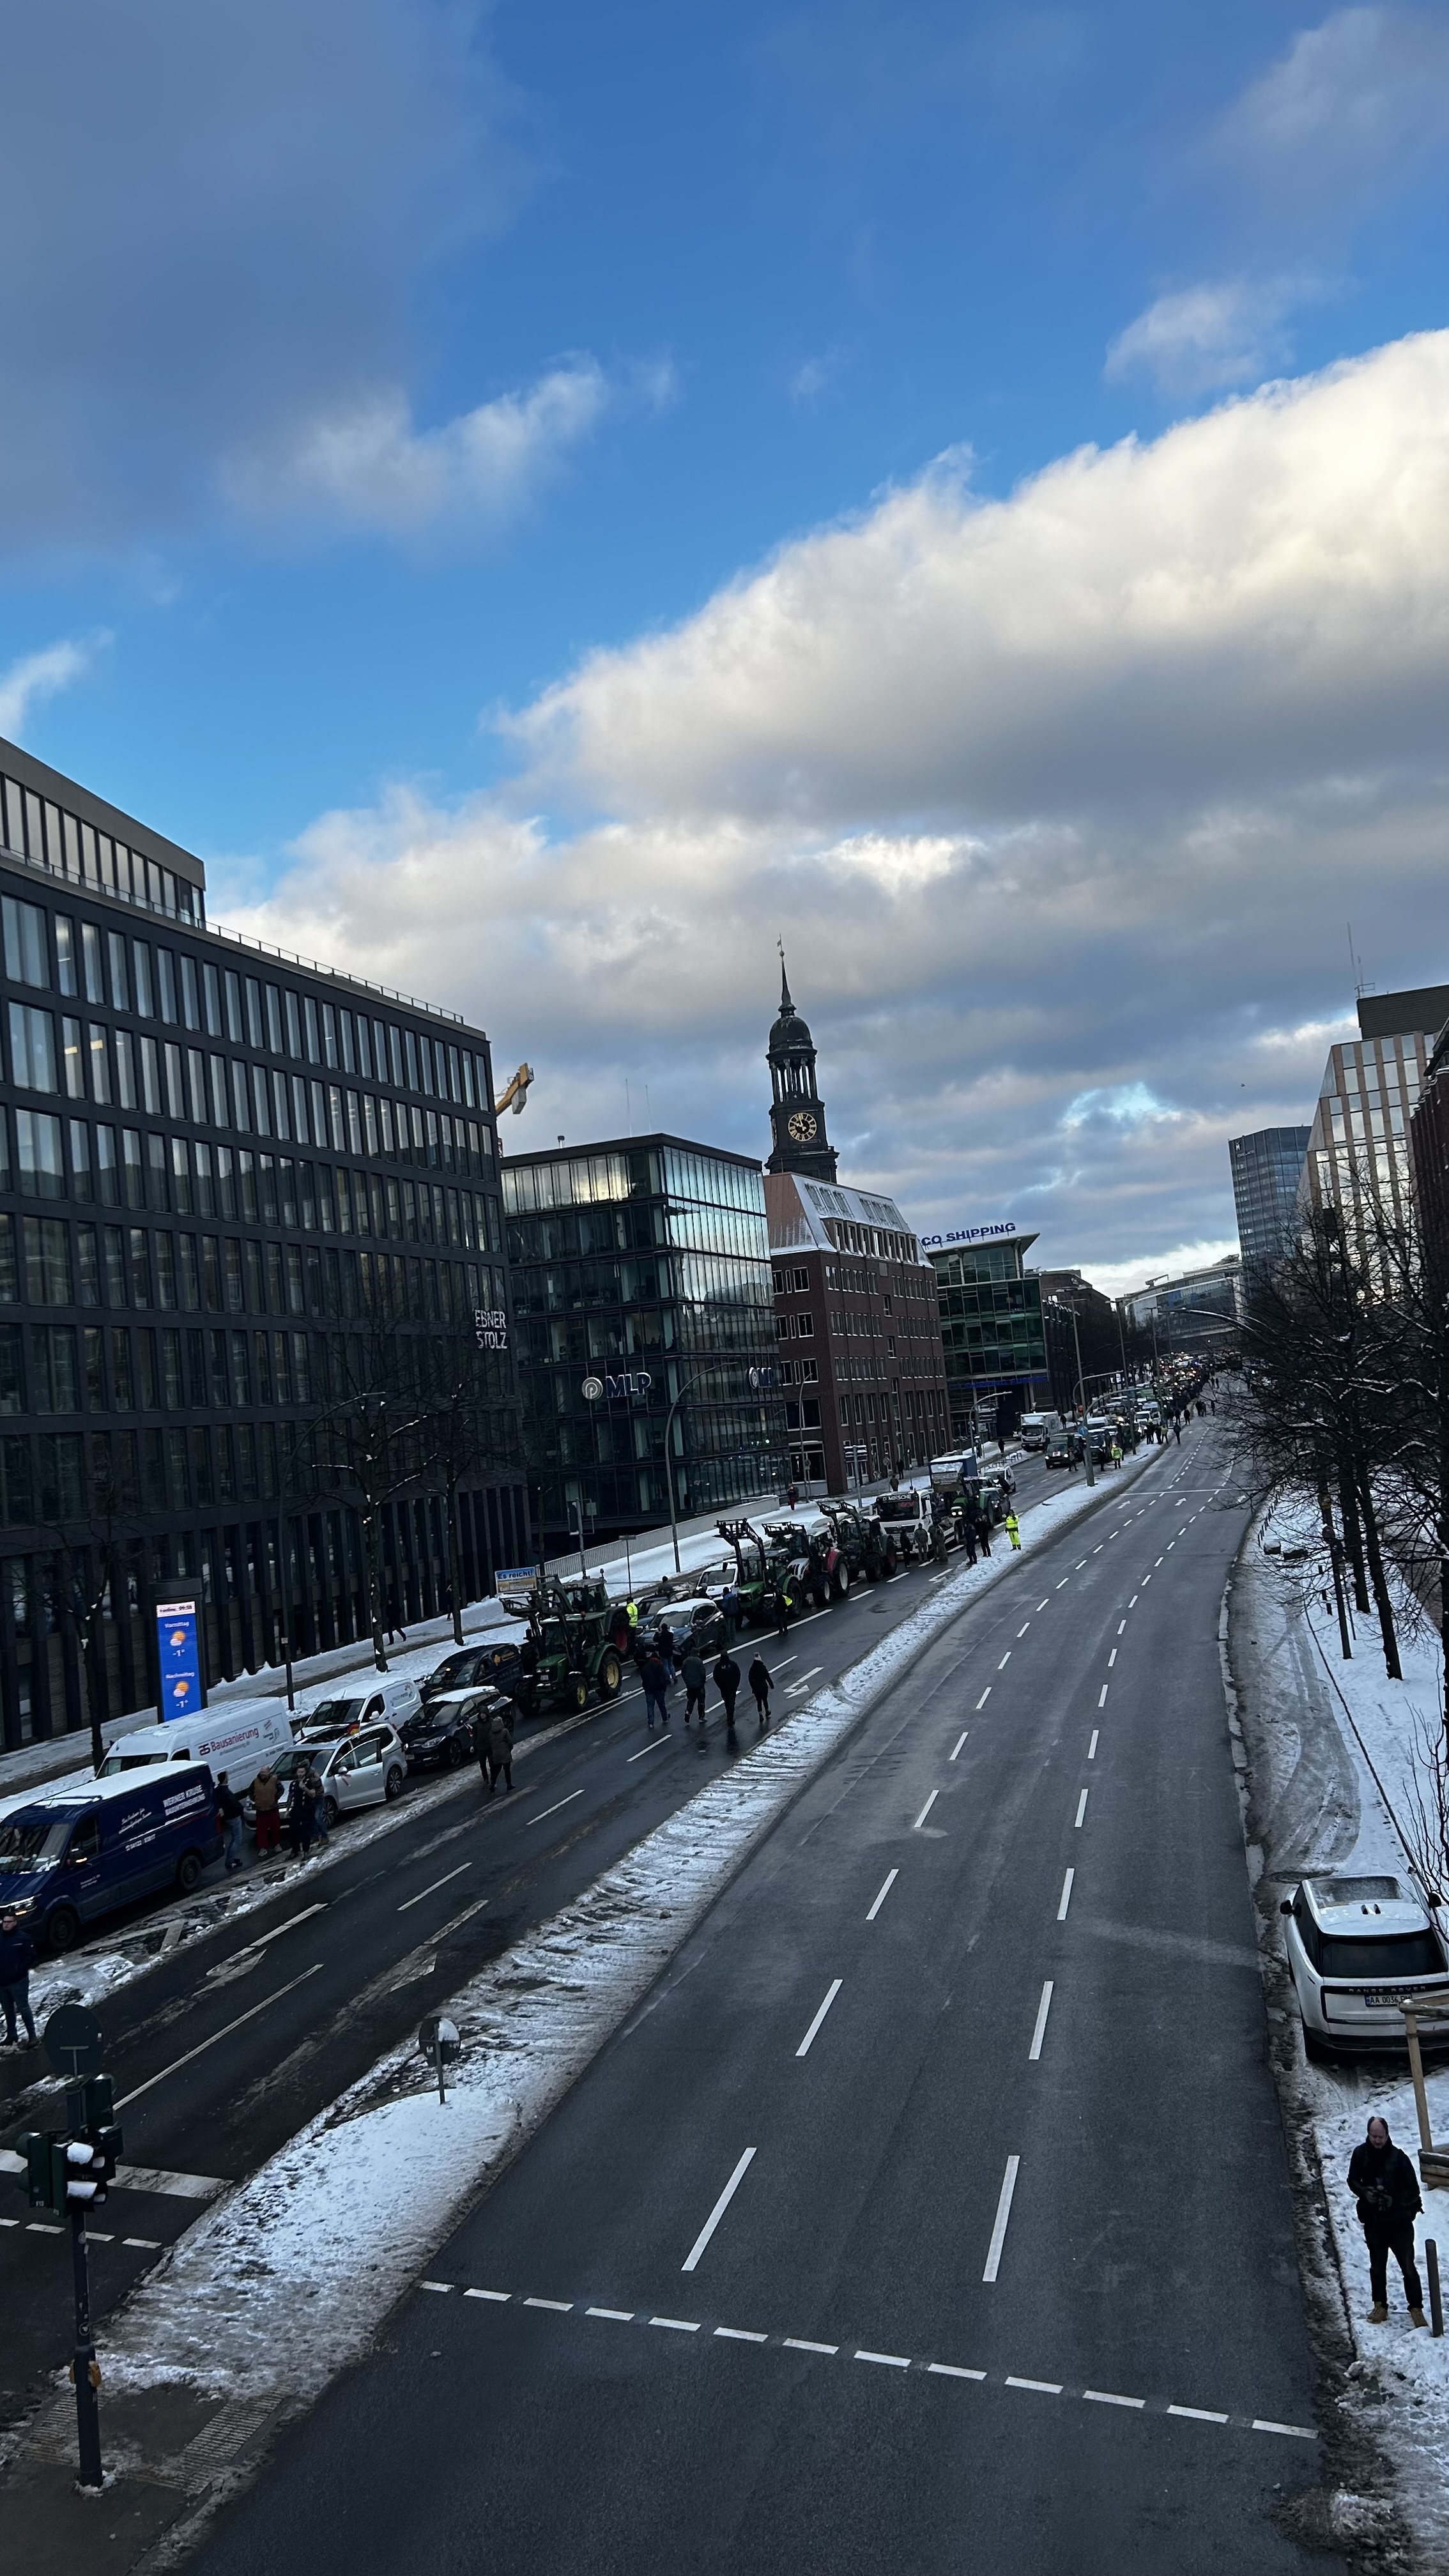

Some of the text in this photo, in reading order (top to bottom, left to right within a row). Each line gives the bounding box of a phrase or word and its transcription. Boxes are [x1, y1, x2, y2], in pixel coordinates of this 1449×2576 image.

[918, 1223, 1016, 1246] CO SHIPPING
[475, 1309, 507, 1328] EBNER
[476, 1331, 508, 1349] STOLZ
[606, 1372, 651, 1398] MLP
[509, 1570, 533, 1578] reicht!
[210, 1728, 259, 1752] Bausanierung
